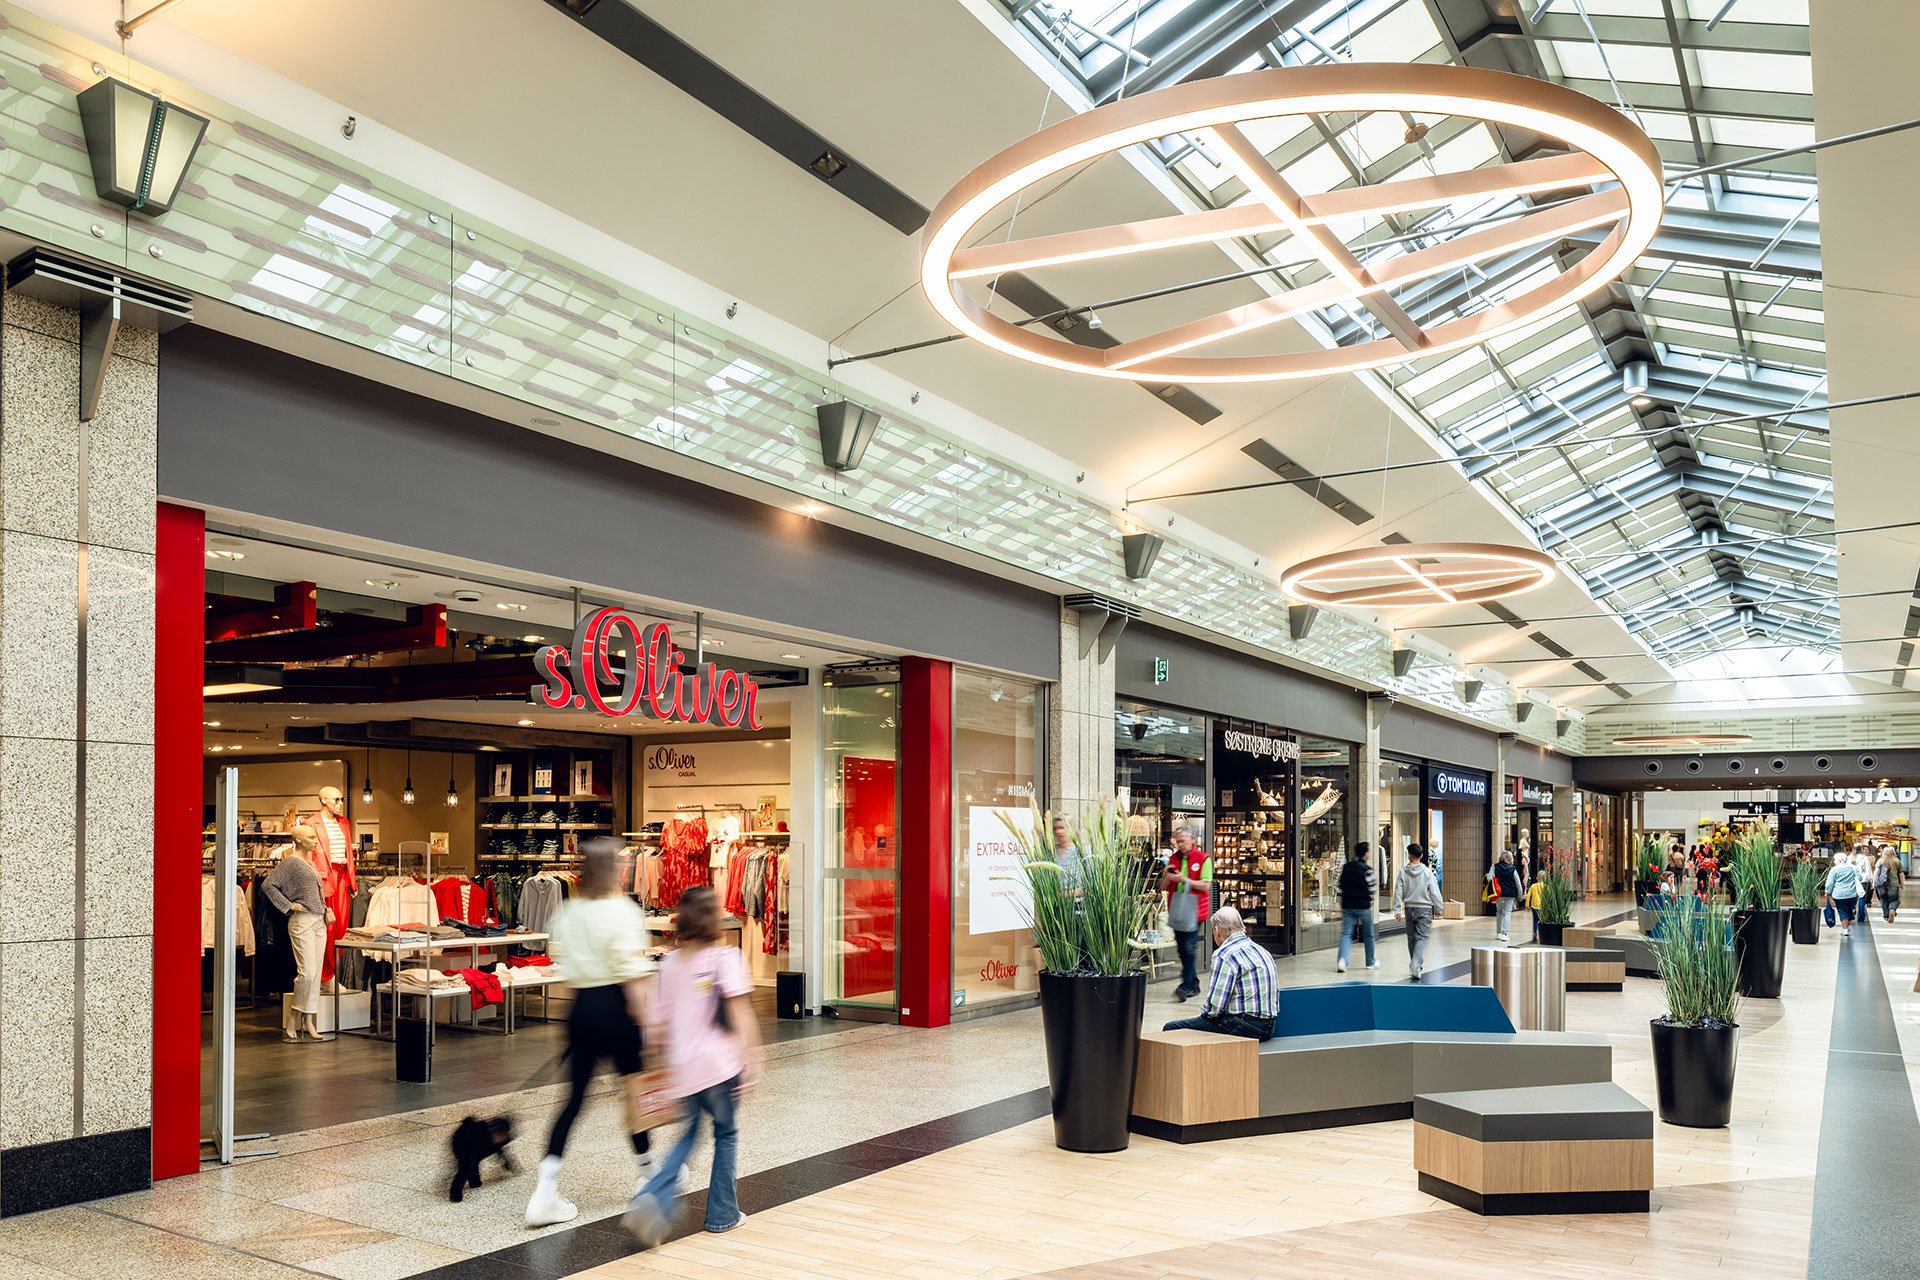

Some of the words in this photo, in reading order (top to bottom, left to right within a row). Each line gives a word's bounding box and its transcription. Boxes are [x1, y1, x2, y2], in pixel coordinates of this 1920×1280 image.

[533, 607, 764, 730] s.Oliver
[648, 746, 696, 770] s.Oliver
[977, 842, 1005, 856] EXTRA
[980, 960, 1018, 981] s.Oliver
